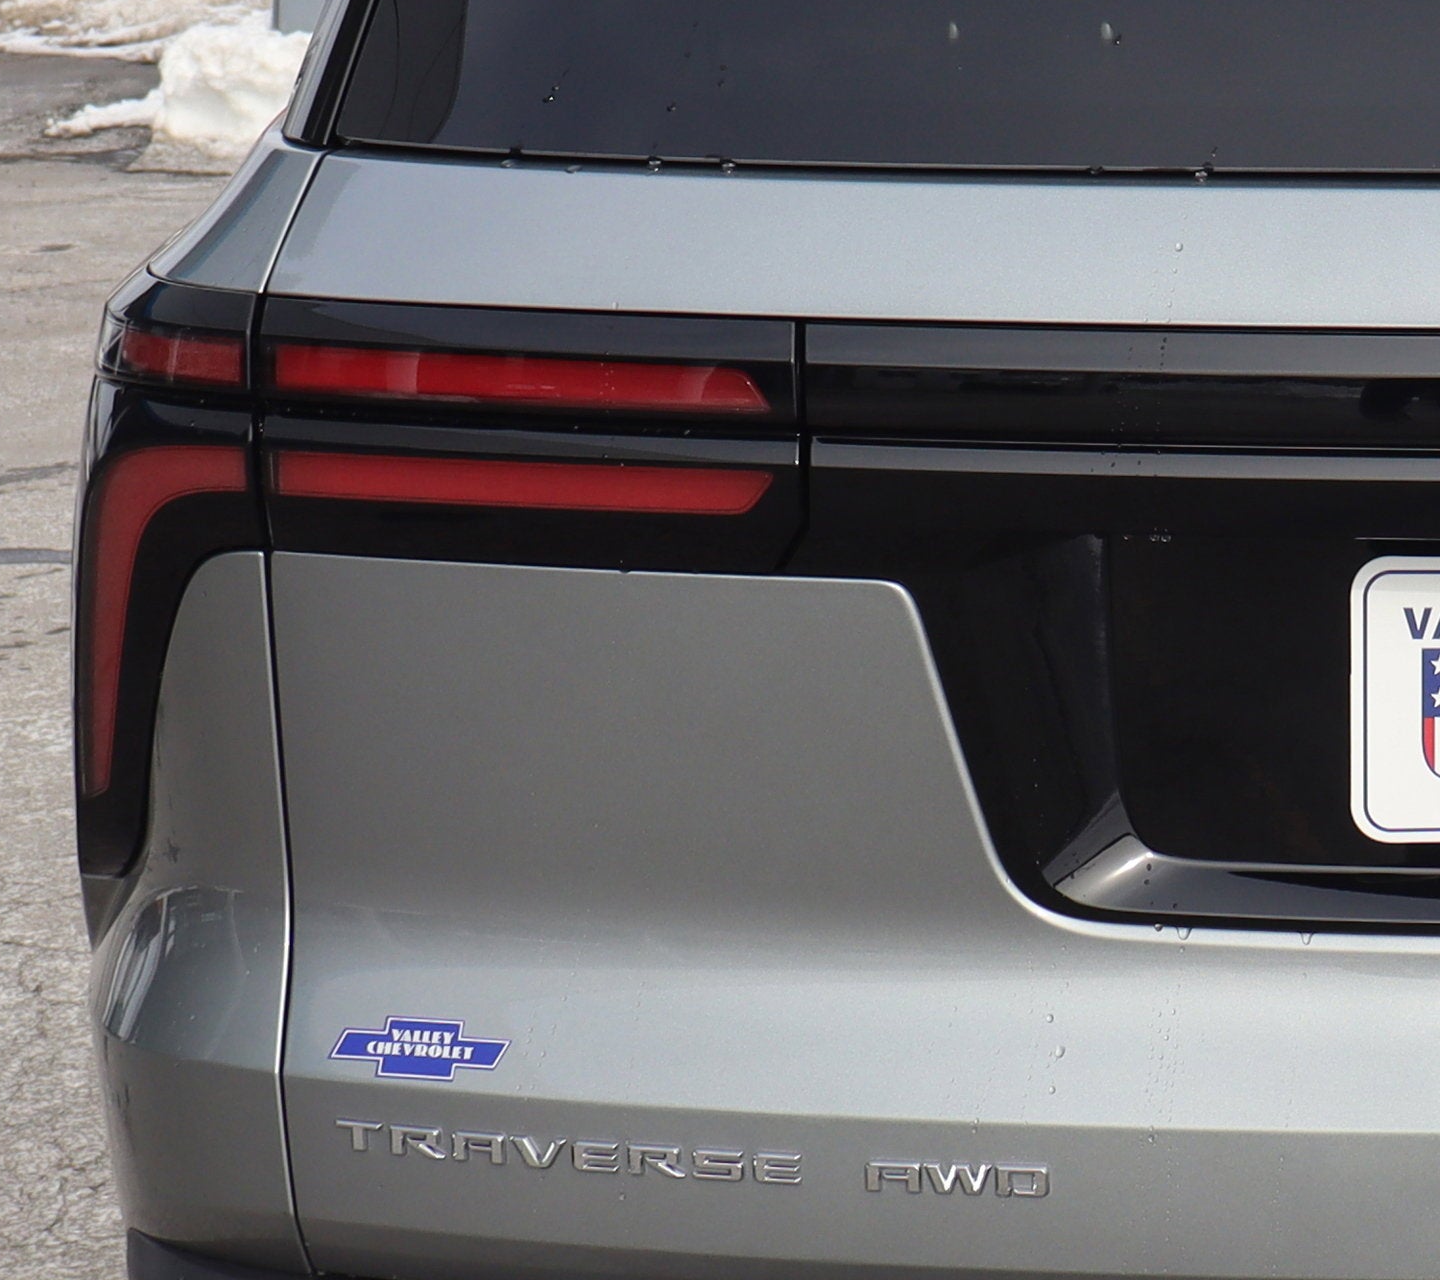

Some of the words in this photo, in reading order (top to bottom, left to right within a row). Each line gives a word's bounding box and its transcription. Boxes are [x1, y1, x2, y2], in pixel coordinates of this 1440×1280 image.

[391, 1028, 456, 1045] VALLEY
[365, 1040, 475, 1061] CHEVROLET
[335, 1118, 804, 1185] TRAVERSE
[863, 1157, 1050, 1198] AWD
